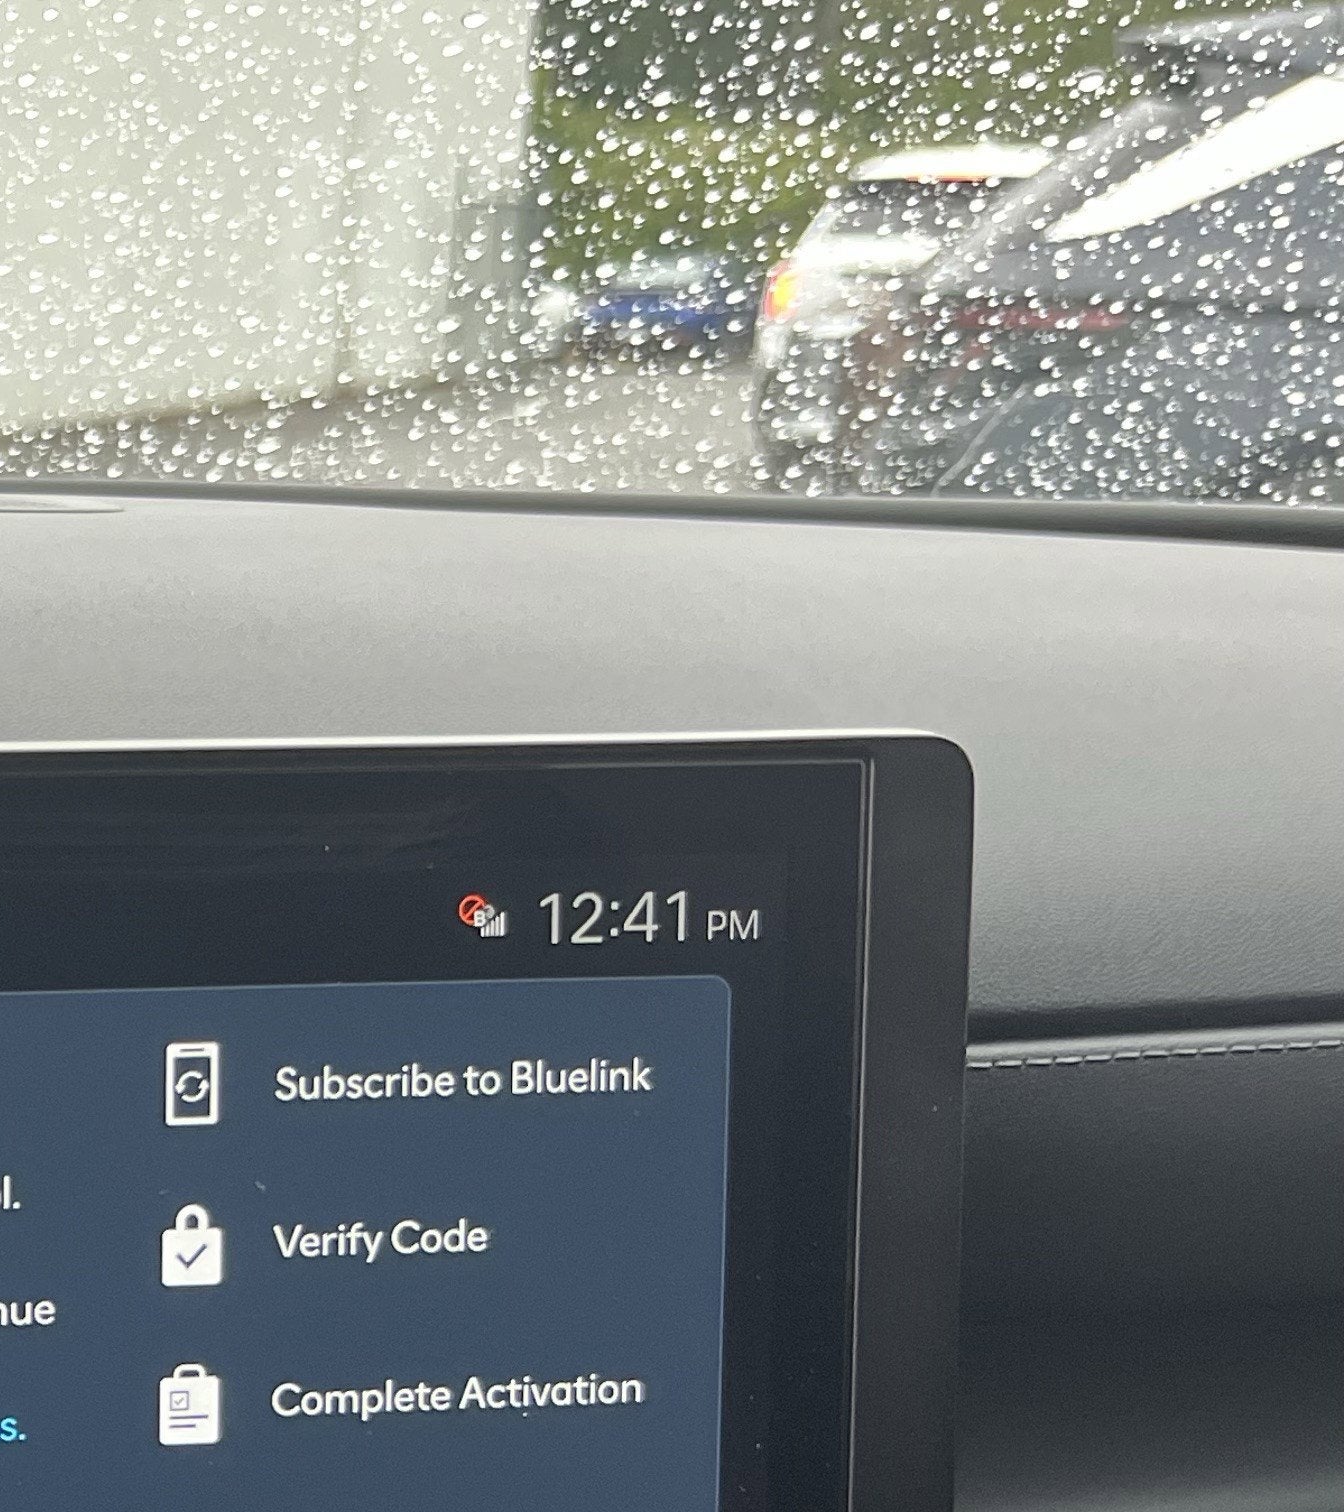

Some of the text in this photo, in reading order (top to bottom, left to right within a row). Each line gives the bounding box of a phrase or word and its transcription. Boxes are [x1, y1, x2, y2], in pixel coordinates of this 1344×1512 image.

[538, 889, 760, 946] 12:41 PM
[273, 1055, 653, 1102] Subscribe to Bluelink
[271, 1216, 490, 1265] Verify Code
[270, 1372, 645, 1423] Complete Activation
